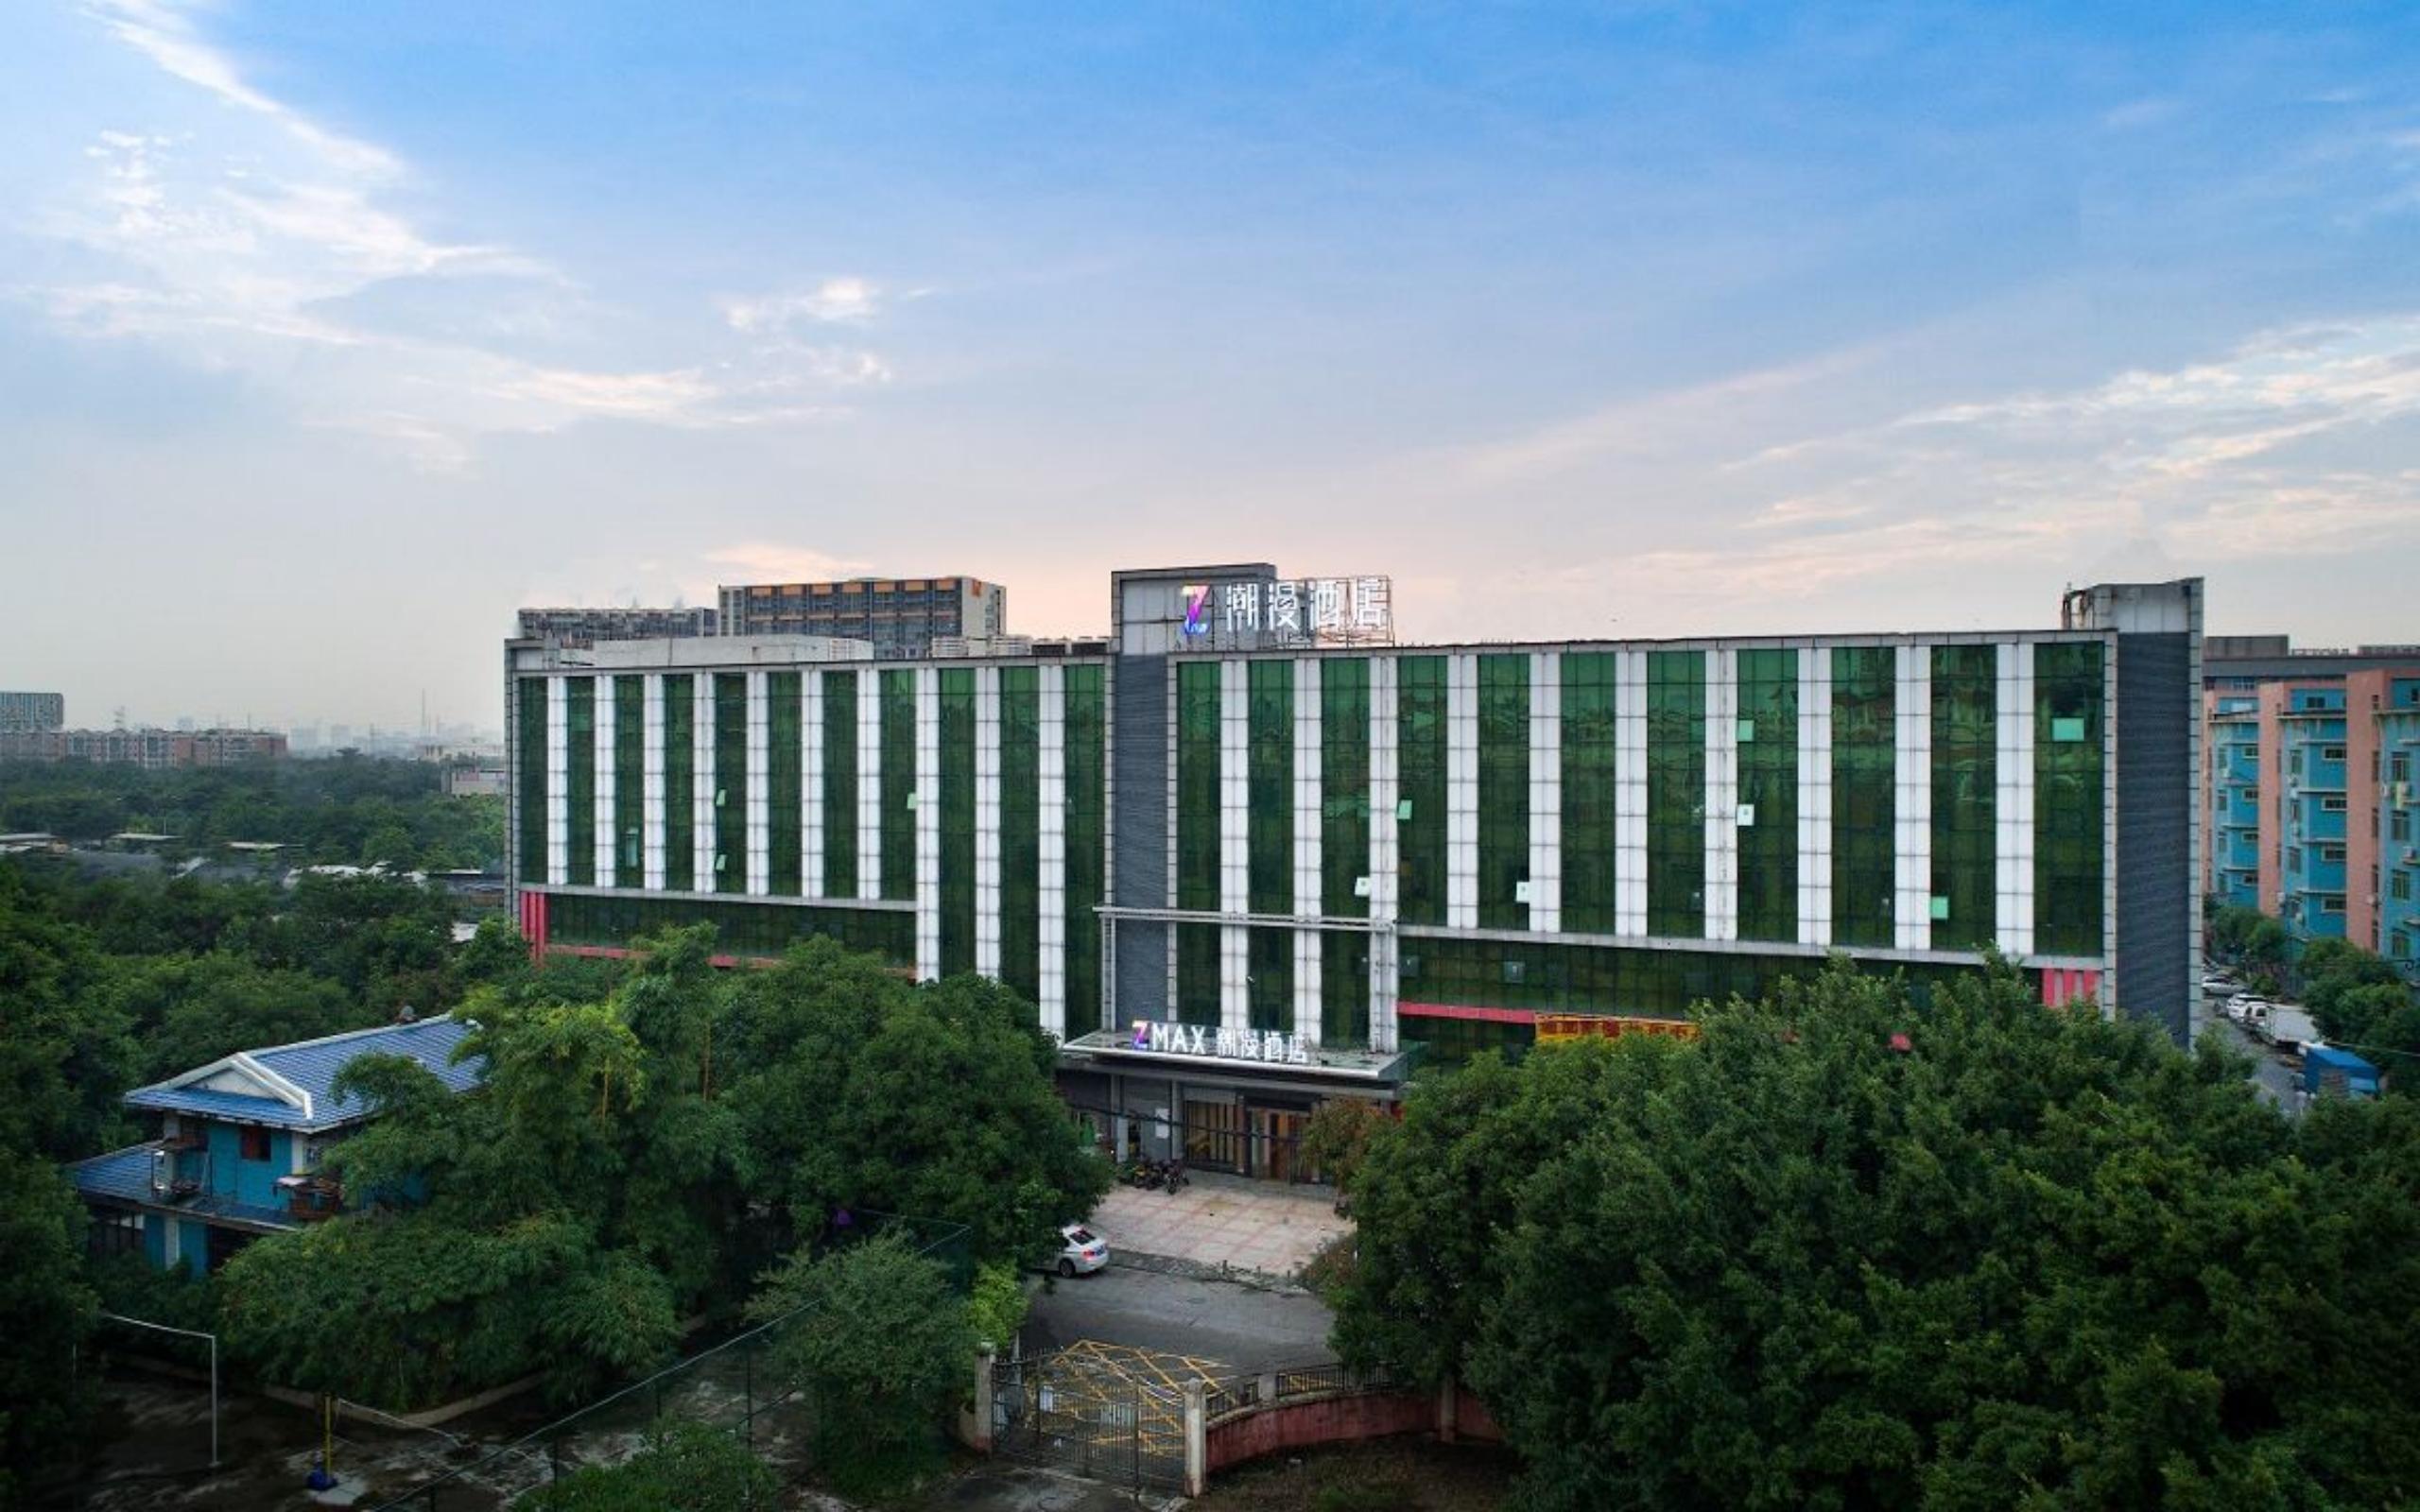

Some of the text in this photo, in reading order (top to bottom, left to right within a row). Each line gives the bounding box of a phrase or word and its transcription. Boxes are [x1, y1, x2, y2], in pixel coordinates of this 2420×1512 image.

[1226, 578, 1383, 631] 潮漫酒店
[1132, 1021, 1206, 1056] ZMAX
